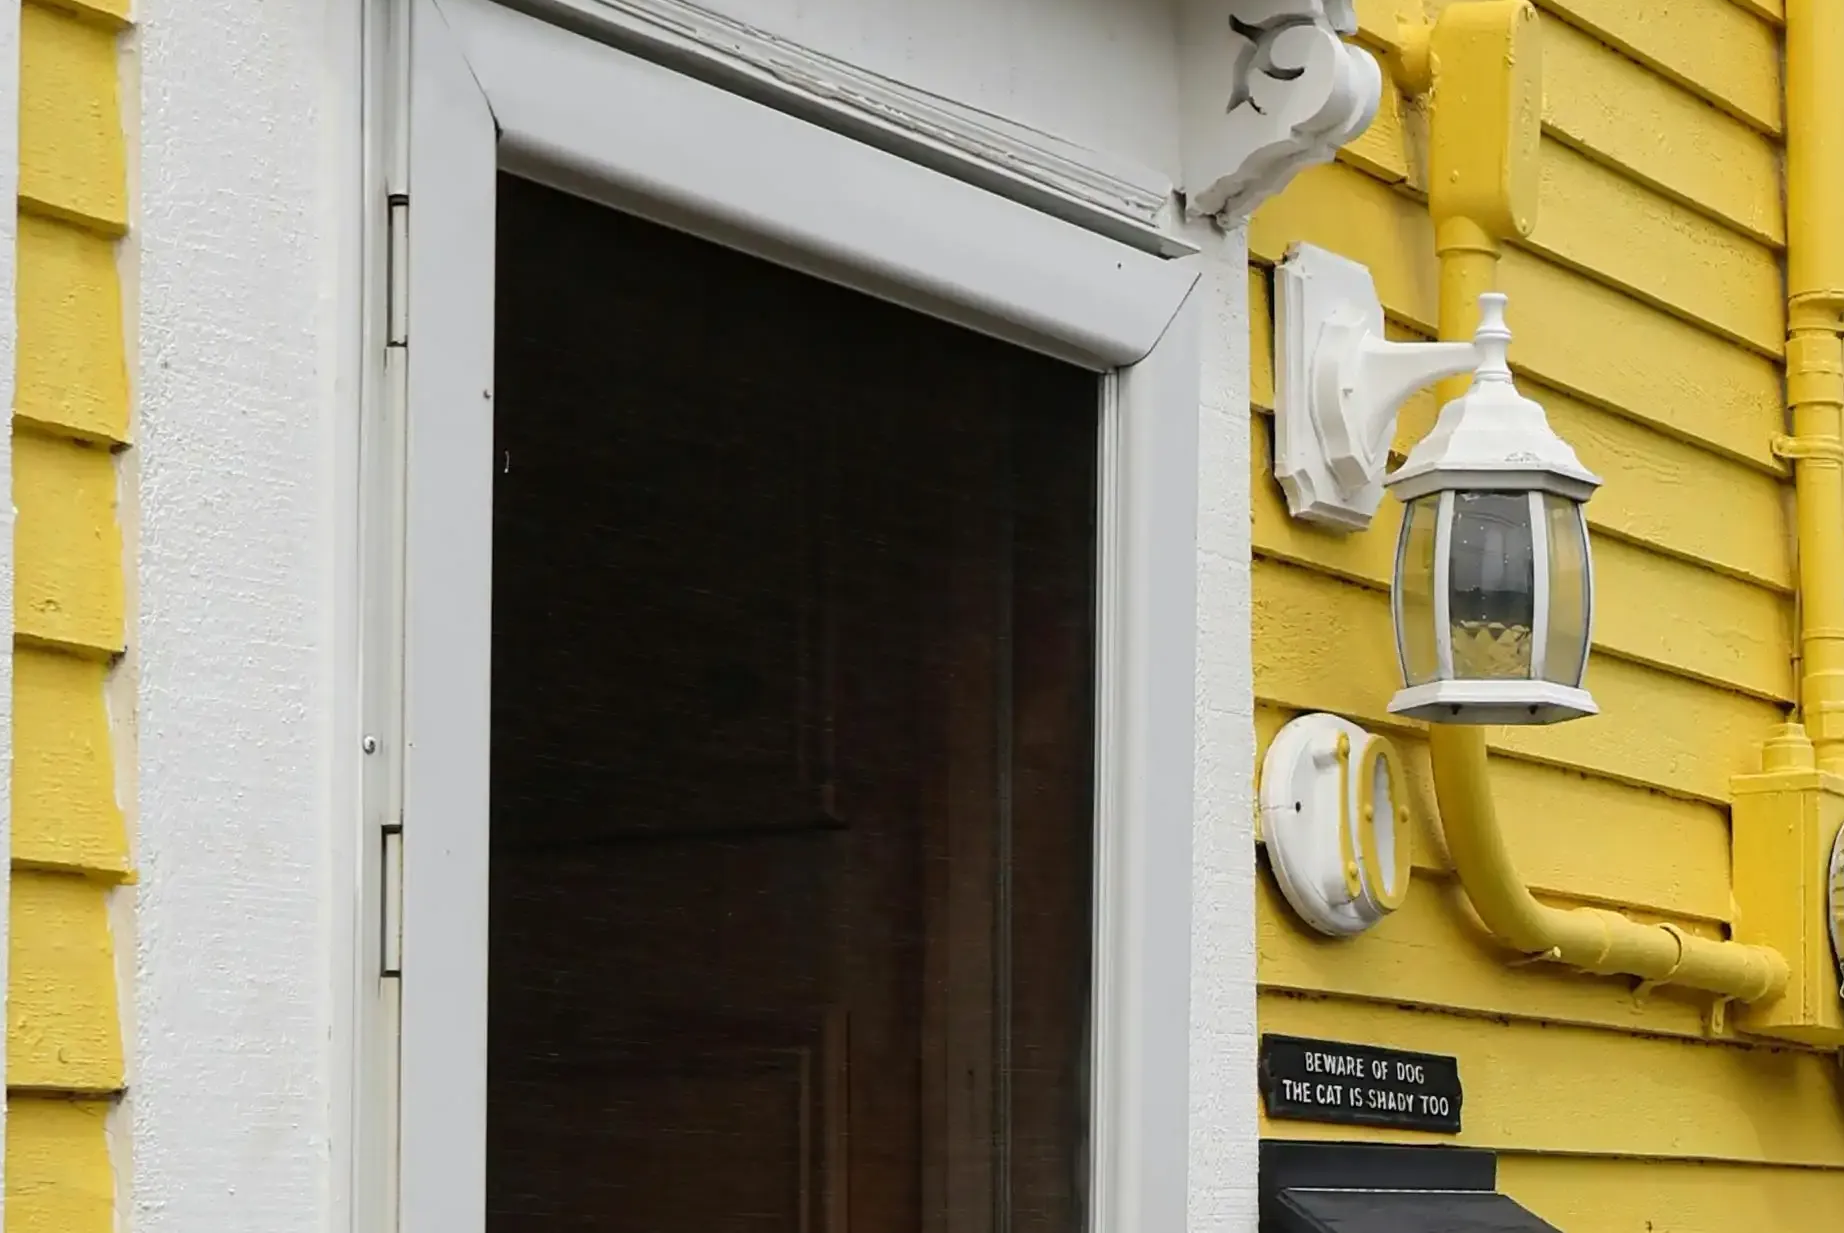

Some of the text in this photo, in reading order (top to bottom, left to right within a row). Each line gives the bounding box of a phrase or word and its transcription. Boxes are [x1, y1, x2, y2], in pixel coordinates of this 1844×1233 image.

[1304, 1051, 1425, 1085] BEWARE OF DOG
[1282, 1079, 1449, 1116] THE CAT IS SHADY TOO
